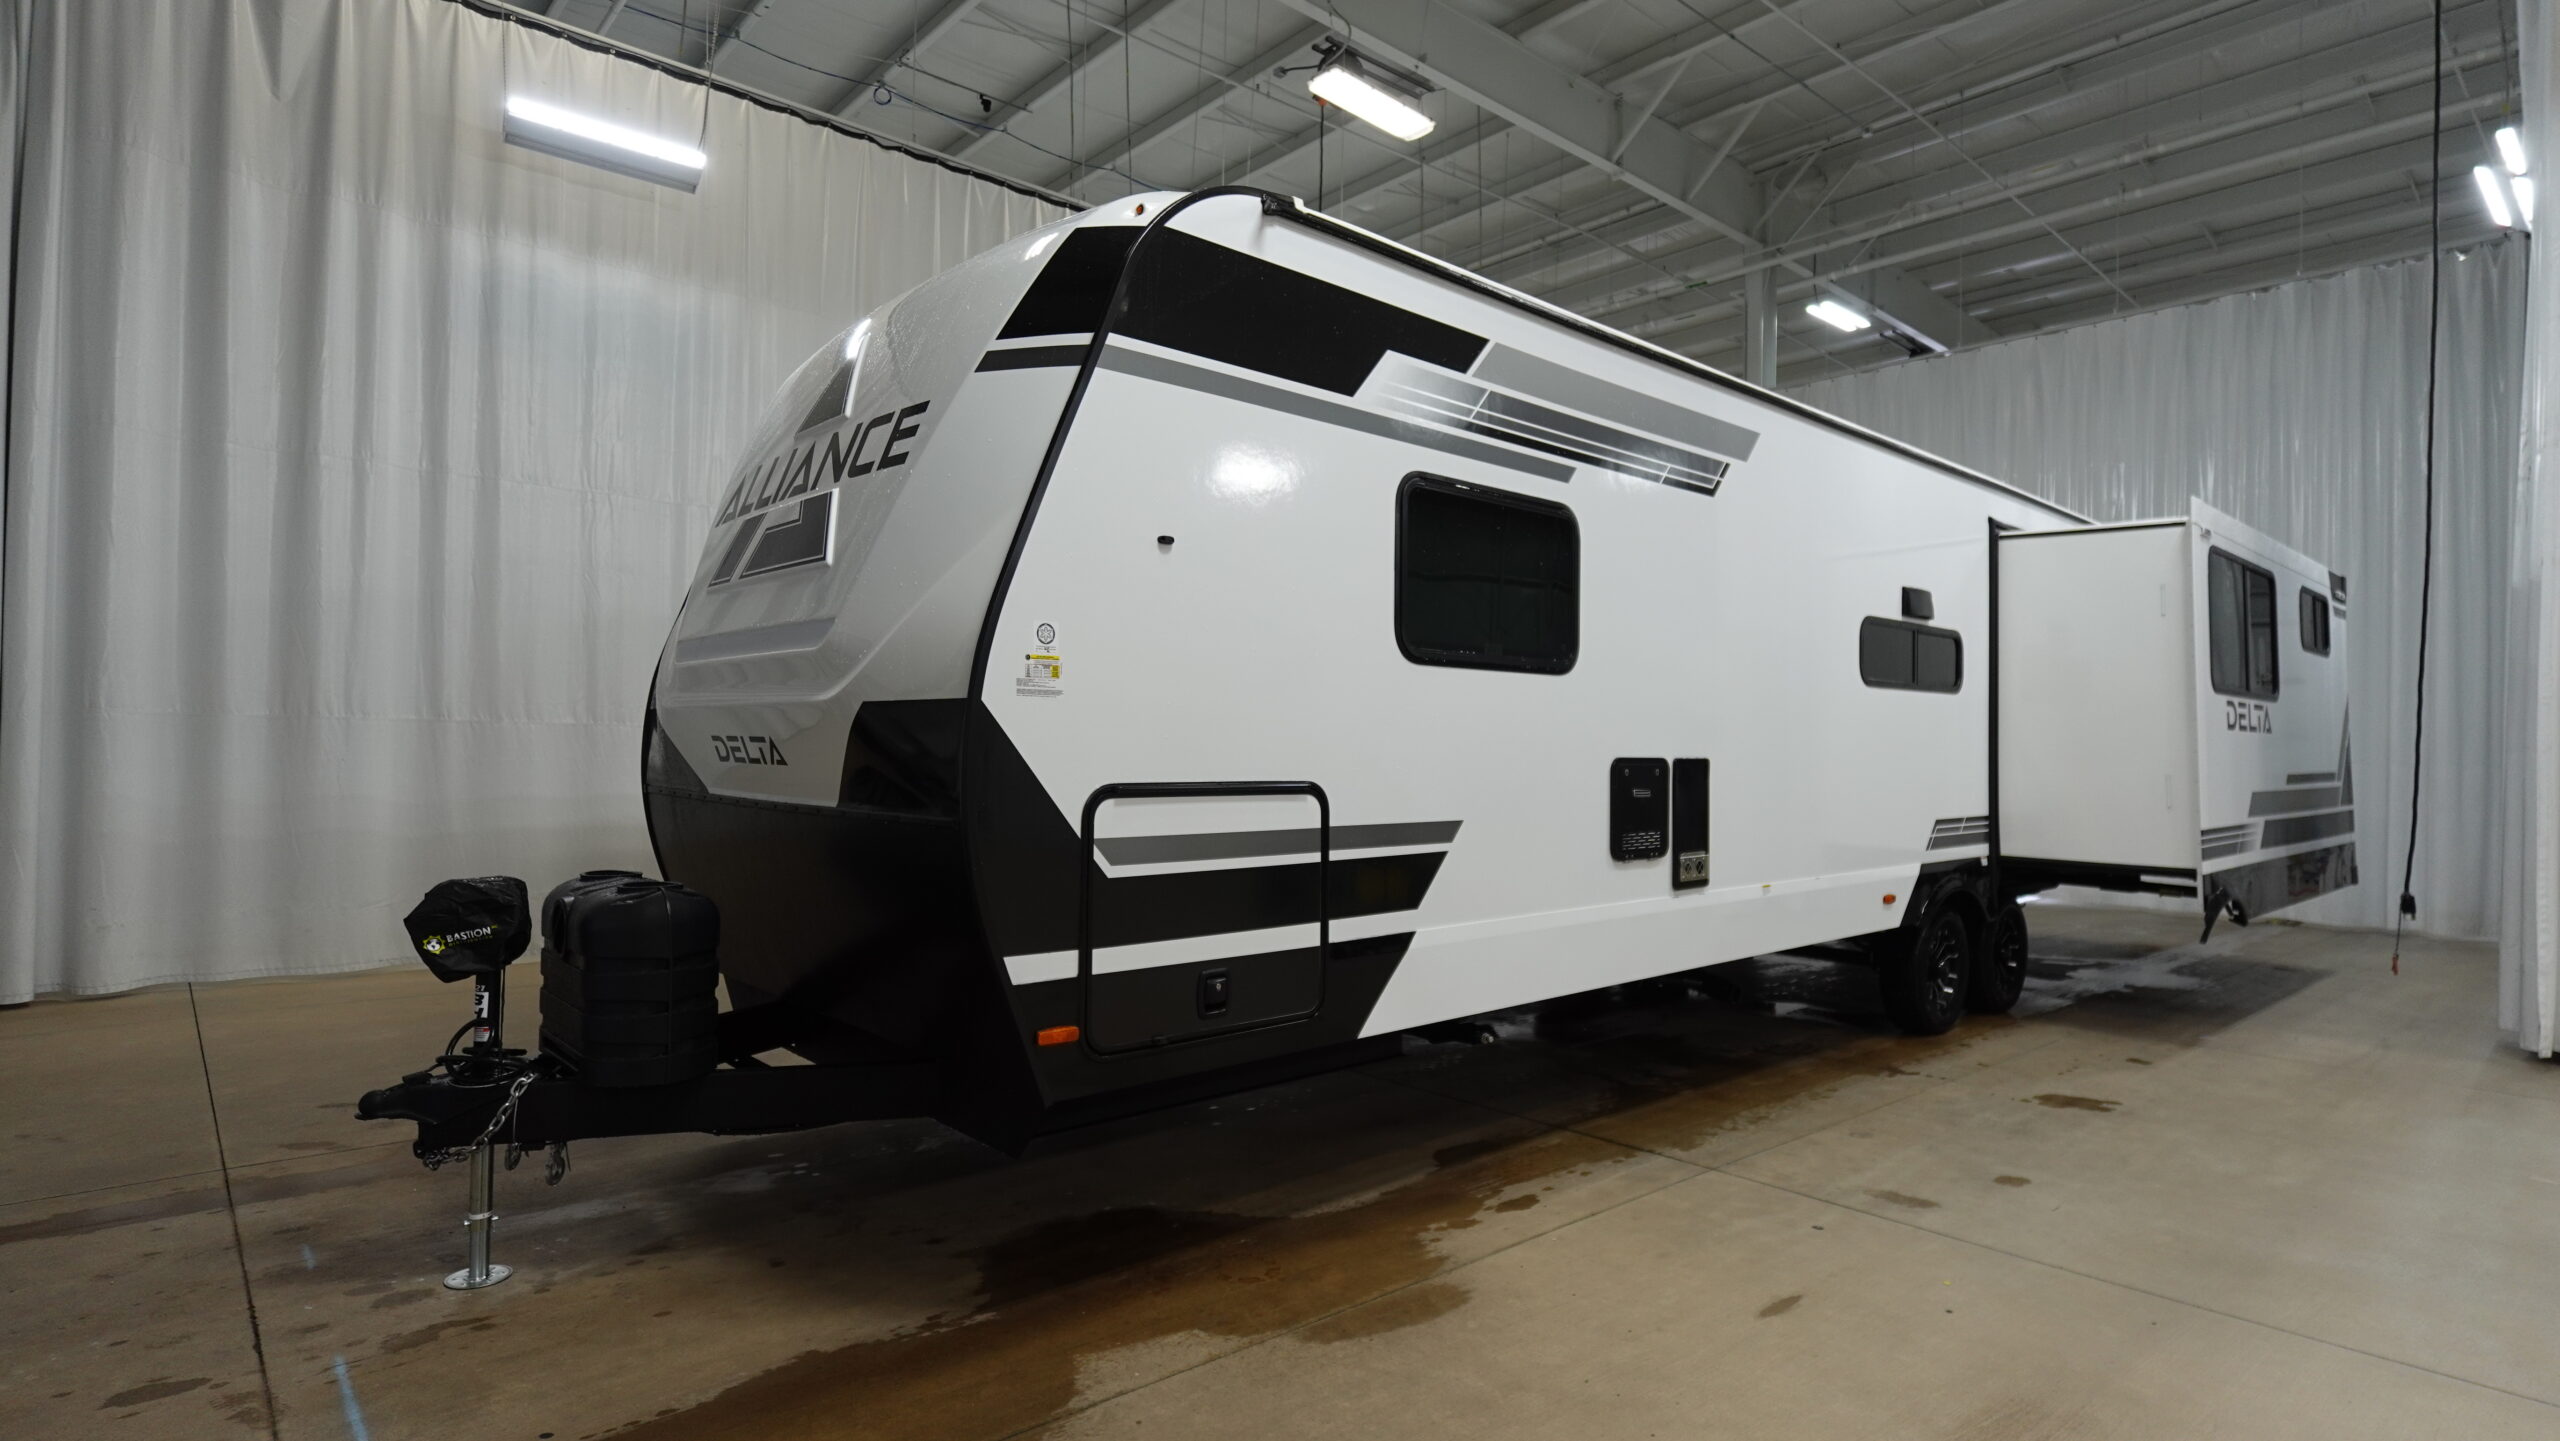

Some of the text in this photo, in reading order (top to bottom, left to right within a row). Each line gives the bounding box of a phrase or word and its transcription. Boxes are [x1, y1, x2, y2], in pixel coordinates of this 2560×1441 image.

[715, 400, 930, 528] ALLIANCE
[2226, 700, 2272, 735] DELTA
[711, 735, 788, 766] DELTA
[446, 926, 492, 943] BASTION
